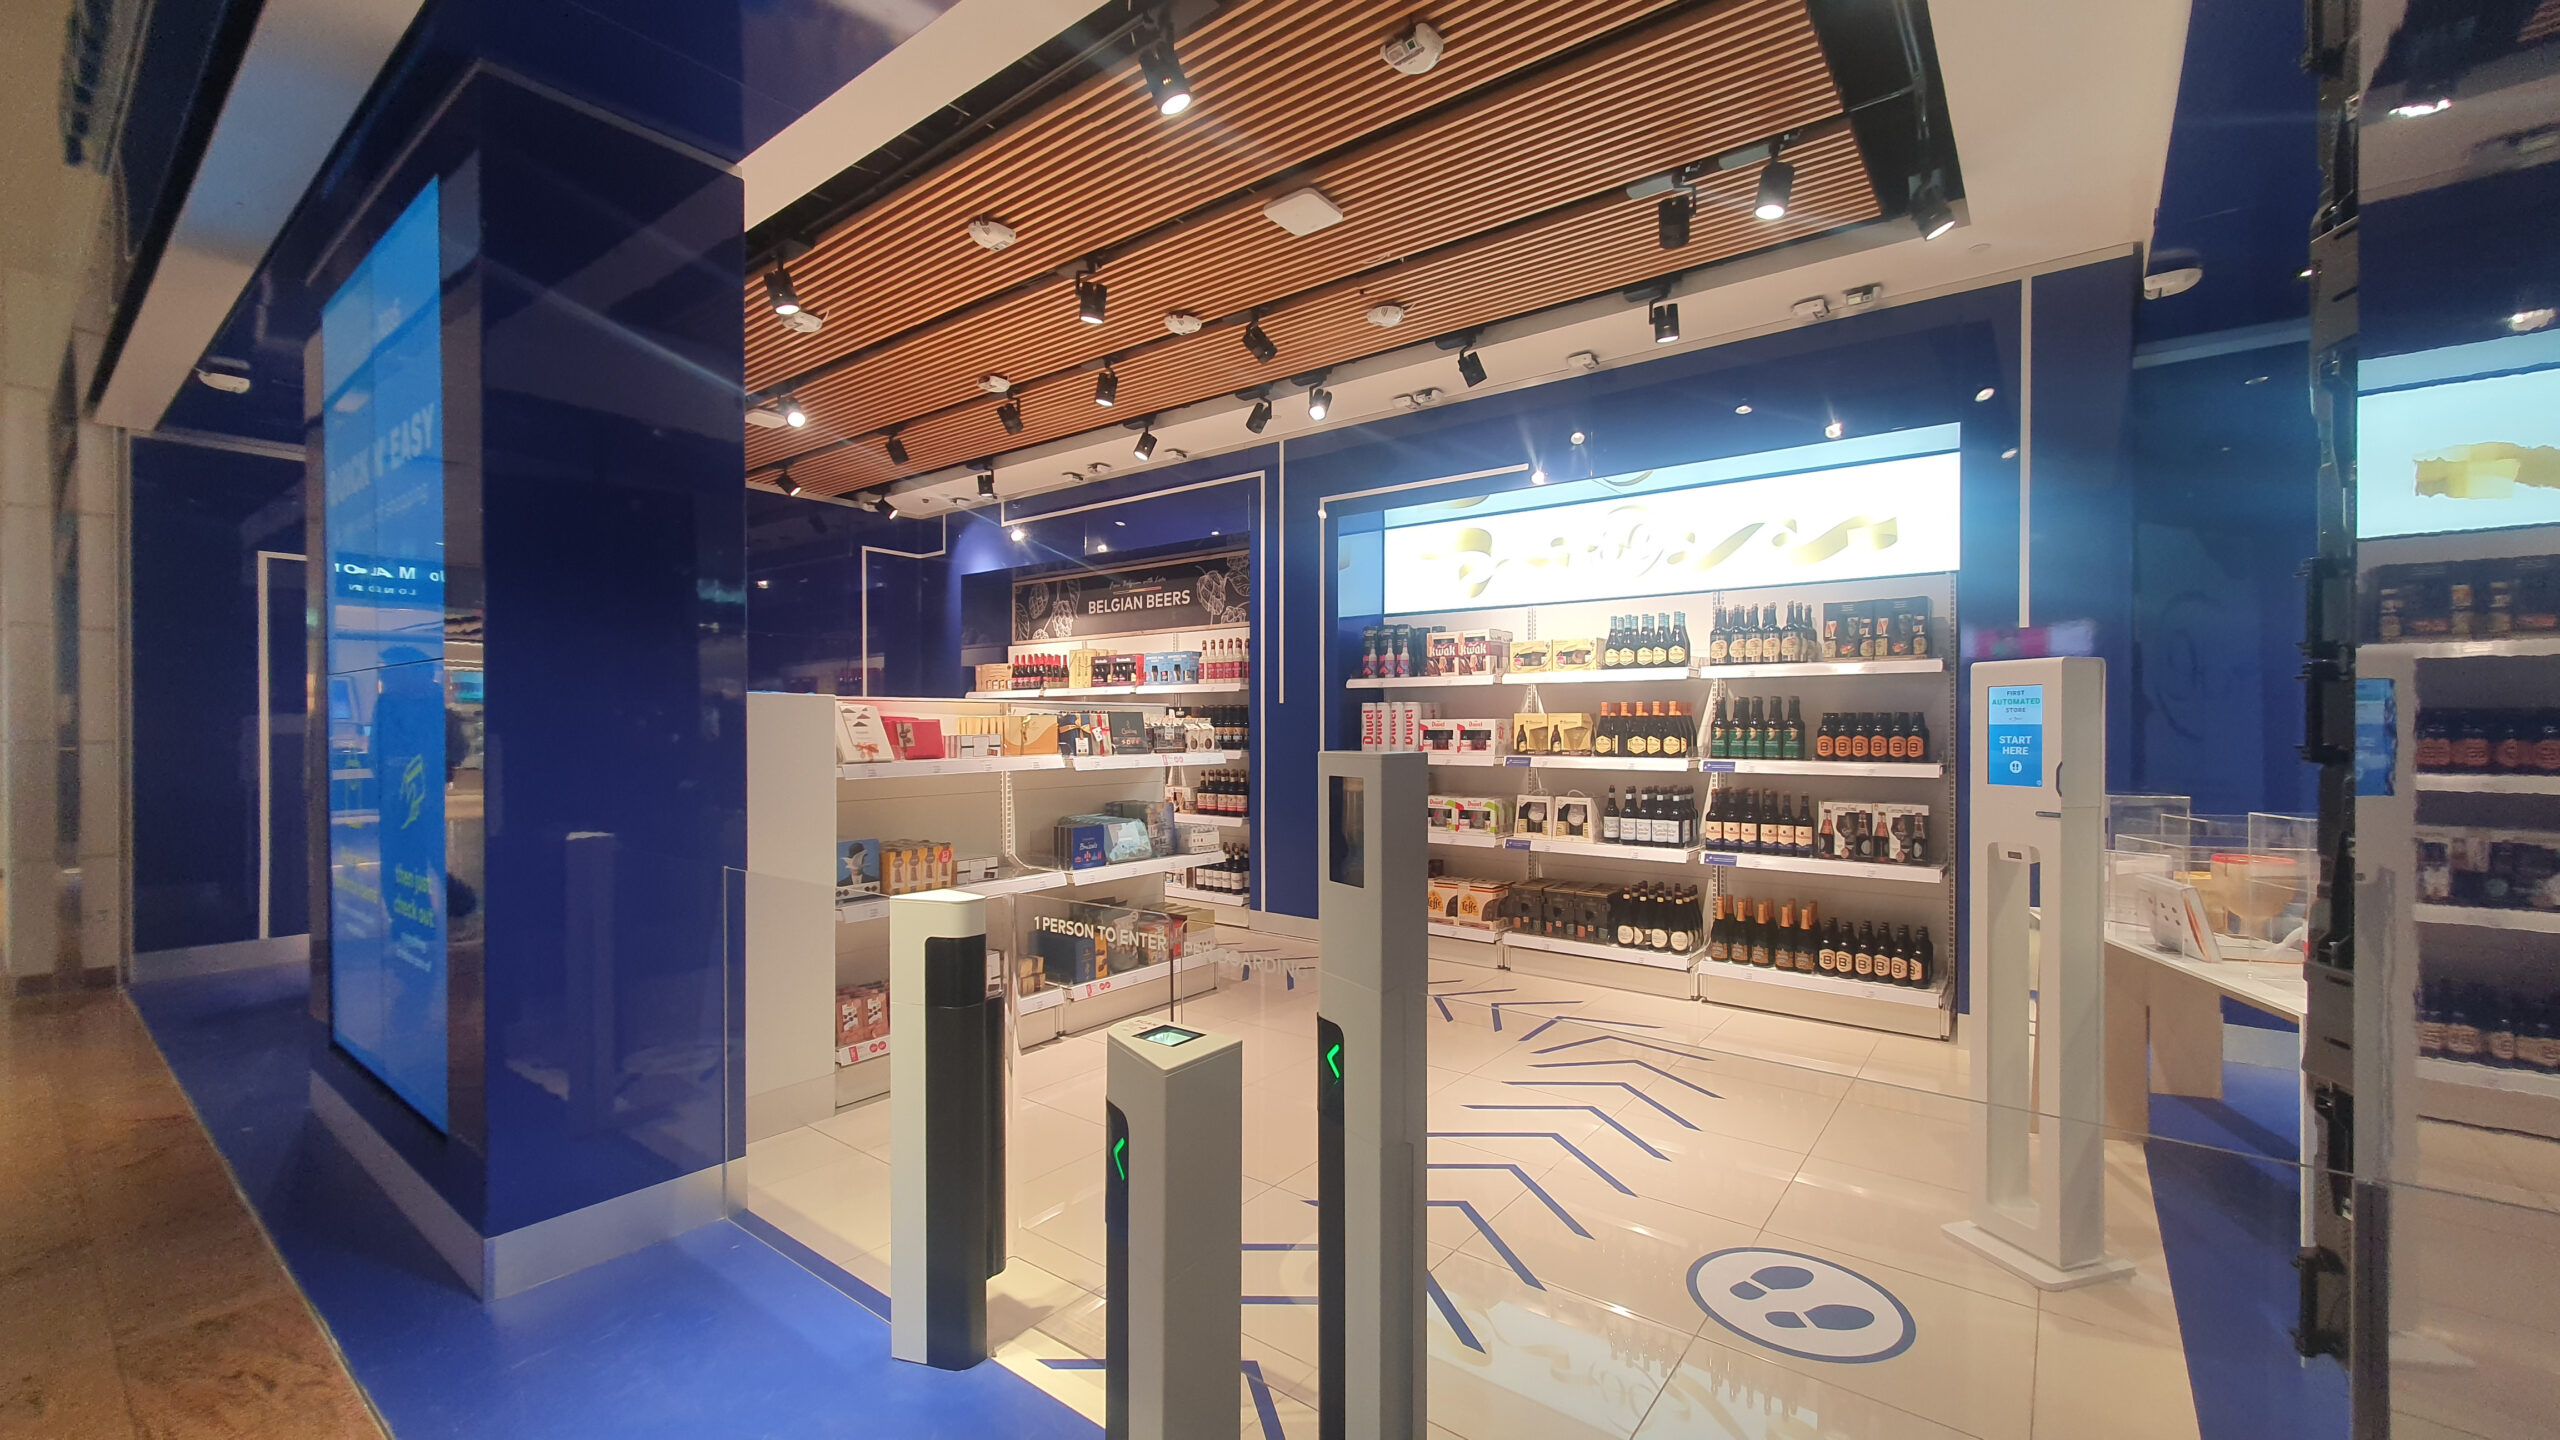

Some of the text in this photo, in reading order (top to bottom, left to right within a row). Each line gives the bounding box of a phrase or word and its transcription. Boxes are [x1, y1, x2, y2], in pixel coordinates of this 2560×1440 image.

[1088, 590, 1191, 615] BELGIAN BEERS
[1991, 697, 2041, 706] AUTOMATED
[1363, 709, 1374, 745] Duvel
[1998, 735, 2033, 745] START
[2002, 746, 2029, 756] HERE
[1461, 900, 1477, 913] Leffe
[1034, 915, 1168, 952] 1 PERSON TO ENTER
[1823, 955, 1832, 964] B
[1838, 957, 1847, 966] B
[1858, 959, 1867, 969] B
[1875, 961, 1885, 971] B
[1893, 963, 1901, 973] B
